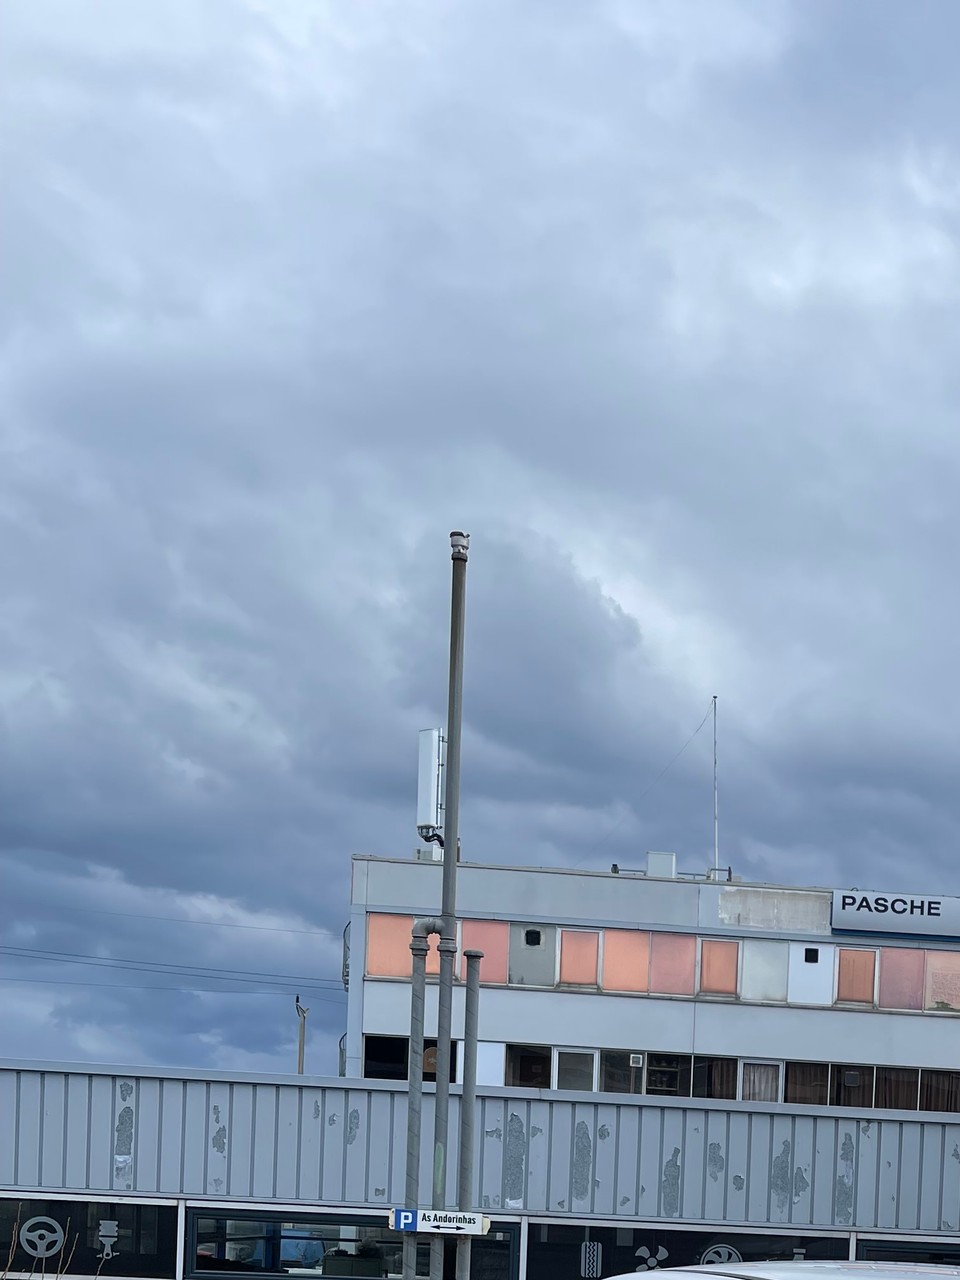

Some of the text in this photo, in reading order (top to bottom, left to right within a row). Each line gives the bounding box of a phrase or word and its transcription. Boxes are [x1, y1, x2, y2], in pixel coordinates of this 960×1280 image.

[841, 895, 942, 917] PASCHE
[400, 1211, 413, 1229] P
[421, 1213, 477, 1225] As Andorinhas
